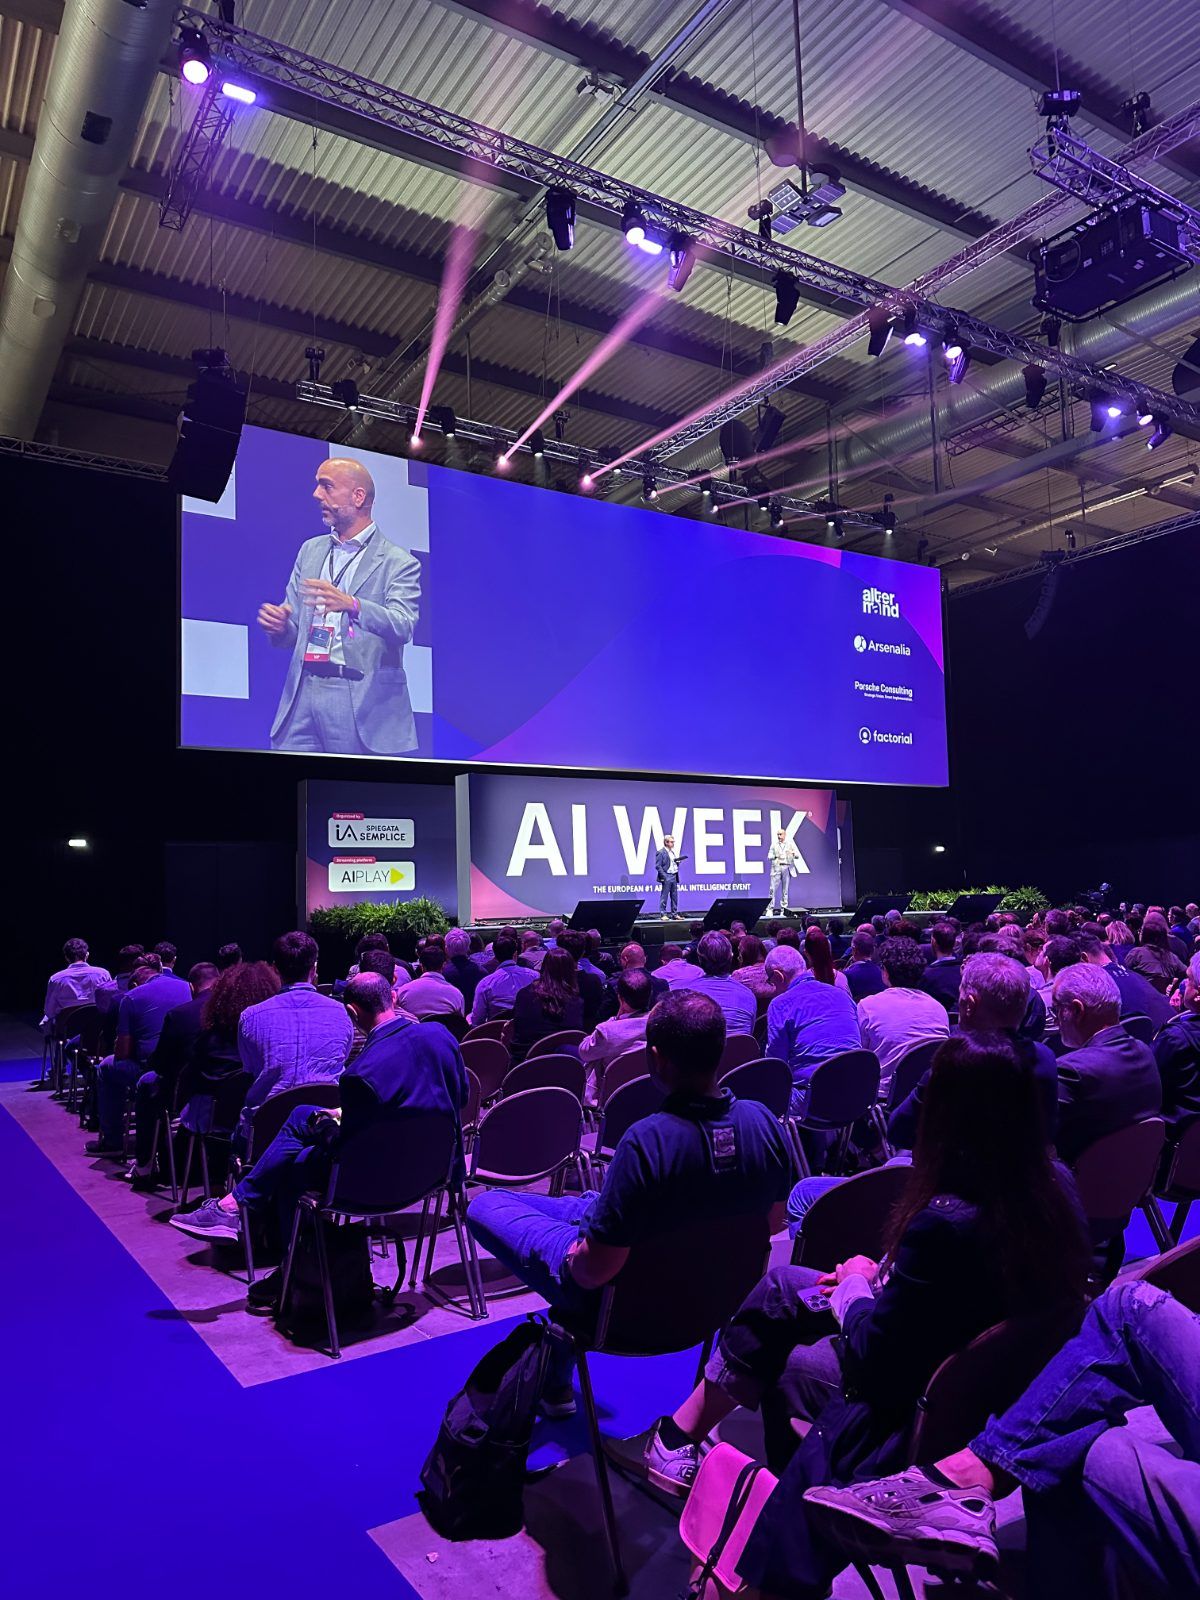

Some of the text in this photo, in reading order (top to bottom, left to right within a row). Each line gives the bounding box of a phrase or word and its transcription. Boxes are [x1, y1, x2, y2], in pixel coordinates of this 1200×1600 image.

[862, 587, 895, 605] alter
[868, 640, 911, 656] Arsenalia
[854, 680, 880, 692] Porsche
[880, 683, 913, 698] Consulting
[873, 729, 913, 745] factorial
[360, 832, 406, 841] SEMPLICE
[505, 802, 811, 877] AI WEEK
[592, 885, 607, 894] THE
[607, 885, 644, 893] EUROPEAN
[689, 883, 732, 892] INTELLIGENCE
[732, 883, 751, 891] EVENT
